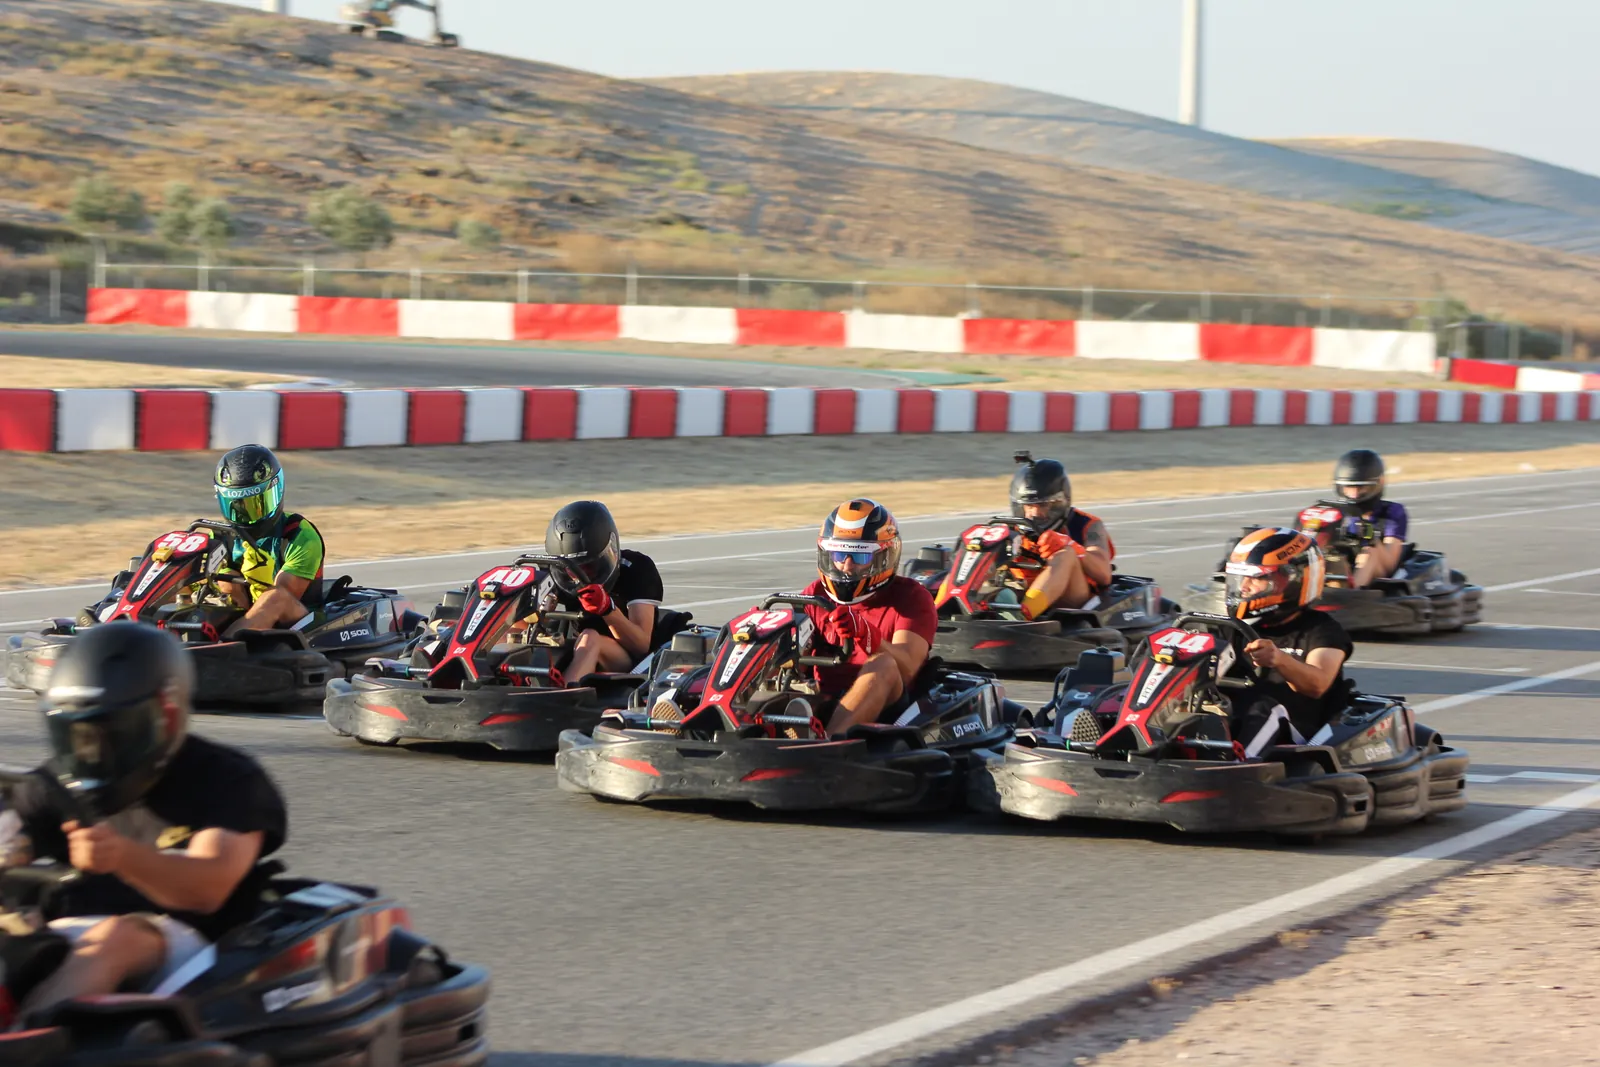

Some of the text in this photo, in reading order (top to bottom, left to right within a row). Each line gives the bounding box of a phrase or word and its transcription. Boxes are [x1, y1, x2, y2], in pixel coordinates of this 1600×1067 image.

[227, 487, 261, 498] LOZANO
[158, 533, 206, 552] 58
[965, 527, 1006, 541] 43
[481, 569, 531, 587] 40
[735, 611, 788, 630] 42
[350, 628, 370, 638] SODI
[1154, 631, 1210, 653] 44
